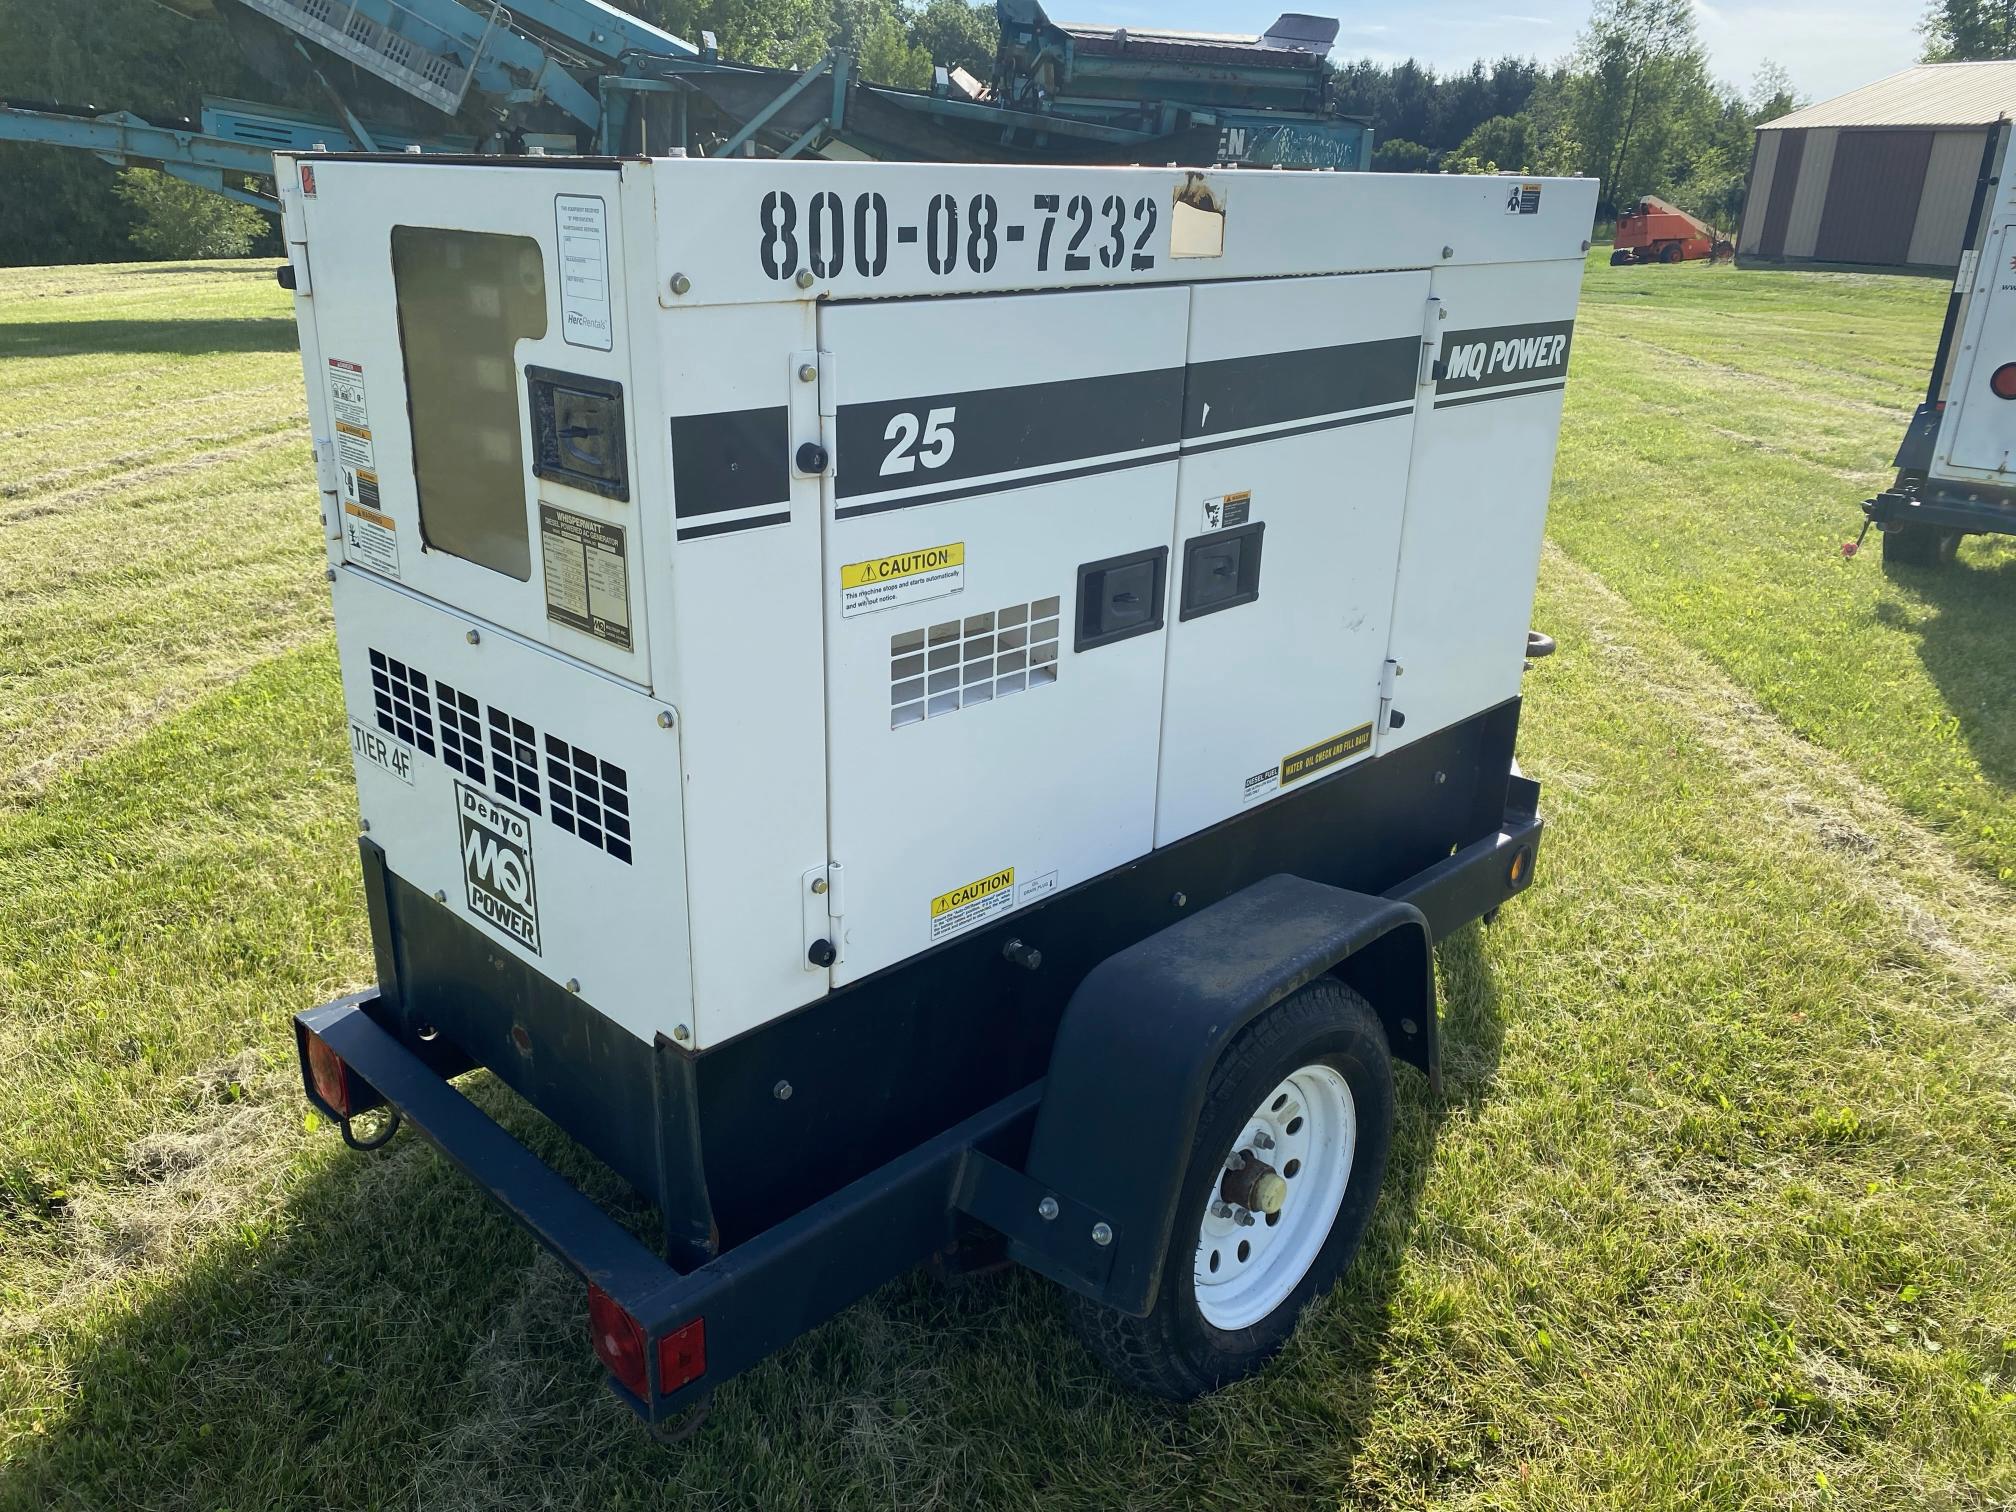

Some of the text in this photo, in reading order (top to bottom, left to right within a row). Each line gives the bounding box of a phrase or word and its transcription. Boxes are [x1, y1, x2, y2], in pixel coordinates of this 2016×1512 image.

[760, 191, 1157, 280] 800-08-7232
[1445, 335, 1566, 381] MQ POWER
[880, 407, 956, 476] 25
[557, 512, 602, 533] WHISPERWATT
[560, 521, 582, 535] POWERED
[583, 529, 590, 538] AC
[590, 533, 619, 547] GENERATOR
[845, 592, 858, 600] This
[883, 583, 898, 592] stops
[910, 578, 925, 586] starts
[926, 570, 959, 583] automatically
[879, 549, 948, 577] CAUTION
[845, 602, 857, 610] and
[352, 724, 410, 779] TIER 4F
[1286, 732, 1369, 776] WATER OIL CHECK AND FILL DAILY
[1246, 768, 1278, 787] DIESEL FUEL
[464, 792, 522, 837] Denyo
[466, 829, 534, 916] MQ
[951, 872, 1010, 906] CAUTION
[472, 886, 534, 943] POWER
